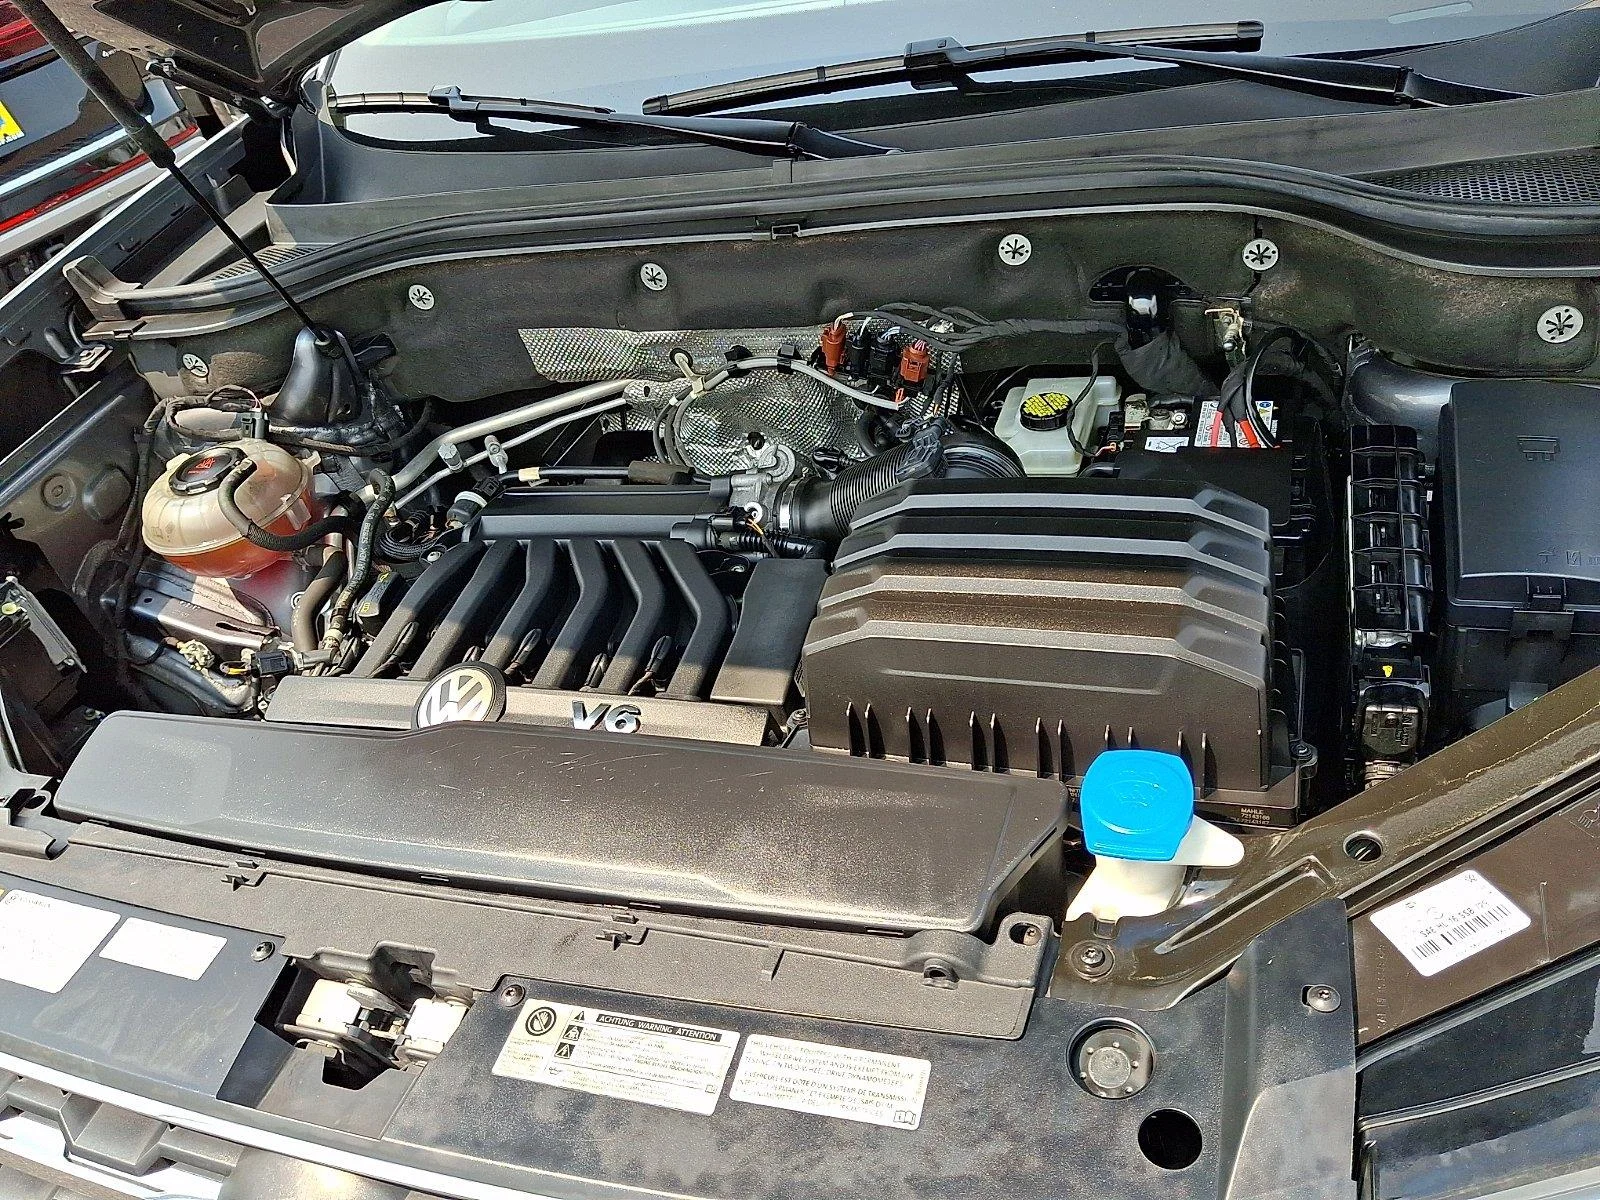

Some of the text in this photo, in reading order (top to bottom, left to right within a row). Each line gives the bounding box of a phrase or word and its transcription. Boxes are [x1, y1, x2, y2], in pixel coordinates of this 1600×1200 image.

[571, 700, 642, 734] V6
[1240, 807, 1265, 815] MAHLE
[599, 1014, 635, 1027] ACHTUNG
[638, 1021, 673, 1033] WARNING
[675, 1027, 718, 1041] ATTENTION
